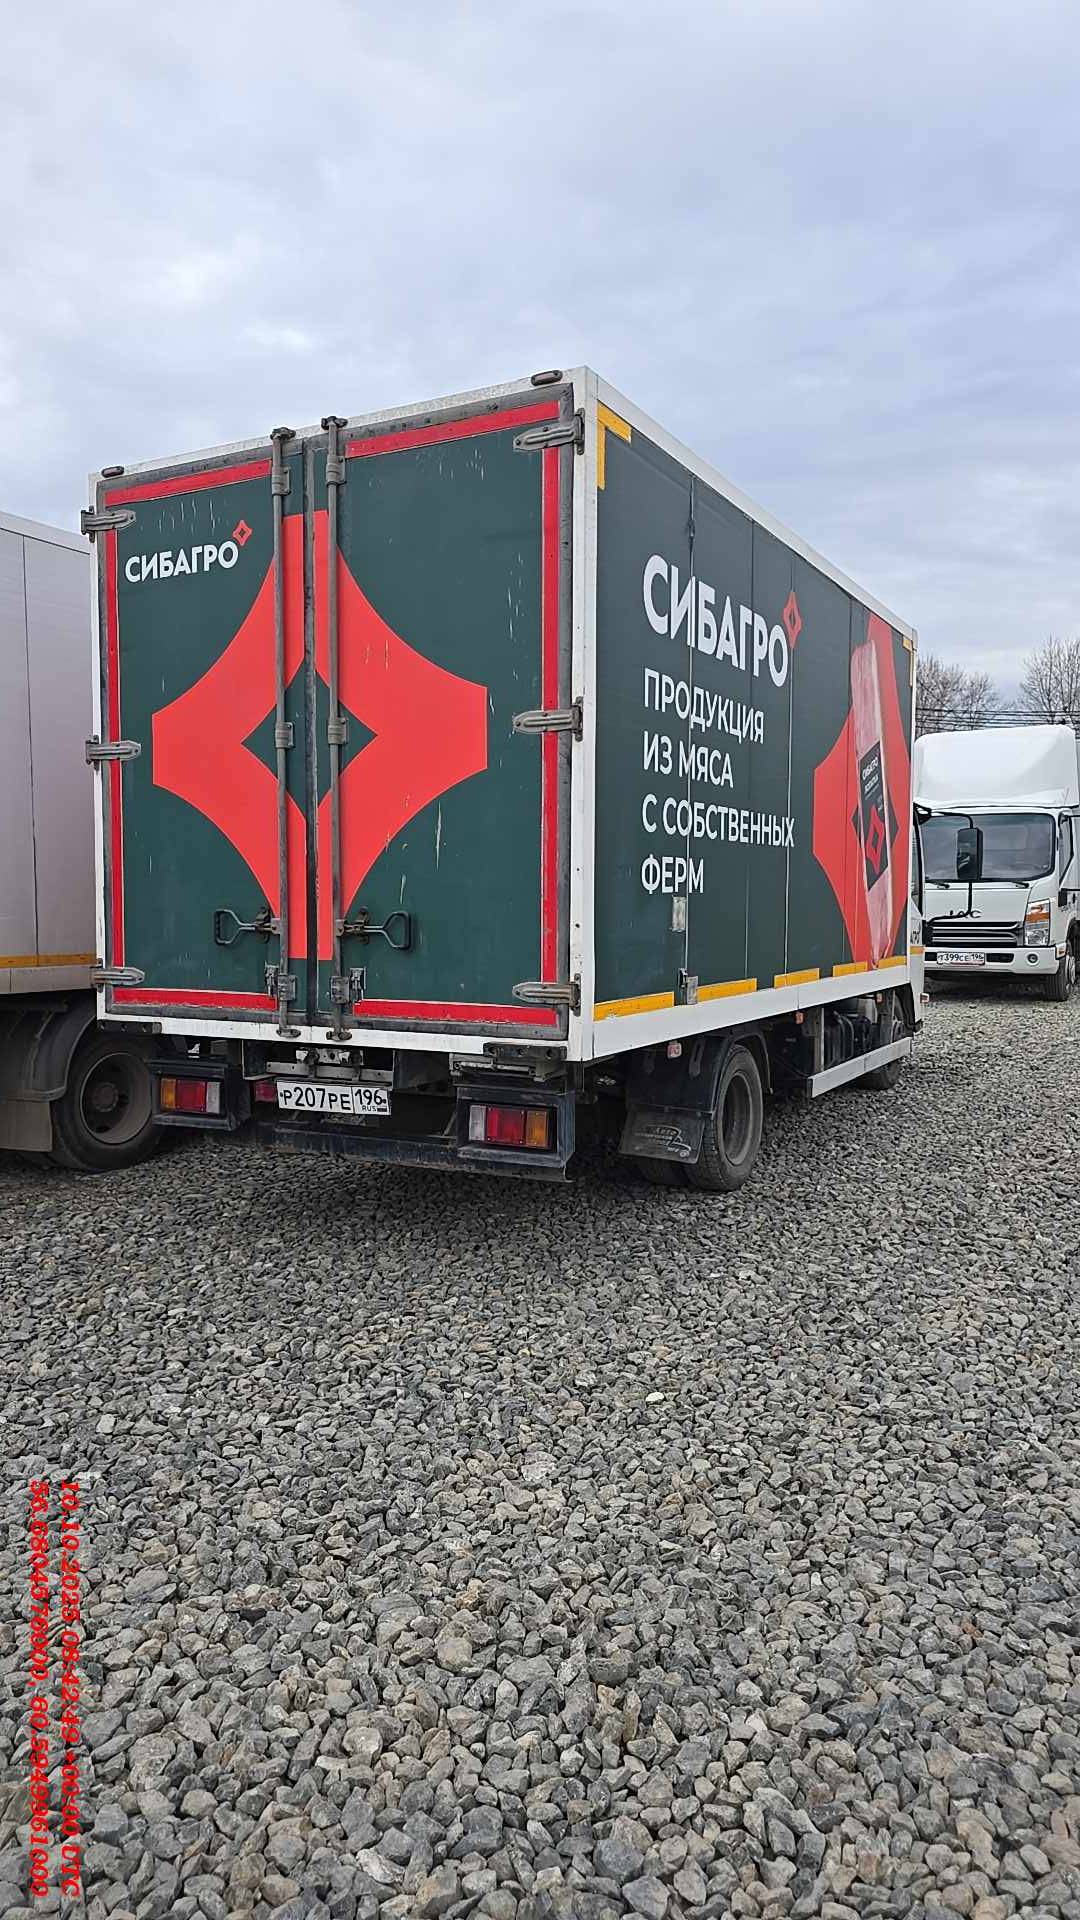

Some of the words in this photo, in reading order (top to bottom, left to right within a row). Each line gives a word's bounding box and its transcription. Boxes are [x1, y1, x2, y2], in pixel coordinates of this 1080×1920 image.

[125, 540, 239, 583] СИБАГРО
[643, 554, 789, 688] СИБАГРО
[643, 667, 764, 745] ПРОДУКЦИЯ
[643, 730, 672, 775] ИЗ
[679, 740, 734, 789] МЯСА
[641, 793, 658, 833] С
[662, 797, 795, 848] СОБСТВЕННЫХ
[641, 853, 704, 894] ФЕРМ
[283, 1086, 352, 1111] Р207РЕ
[354, 1088, 383, 1106] 196
[361, 1104, 377, 1112] RUS
